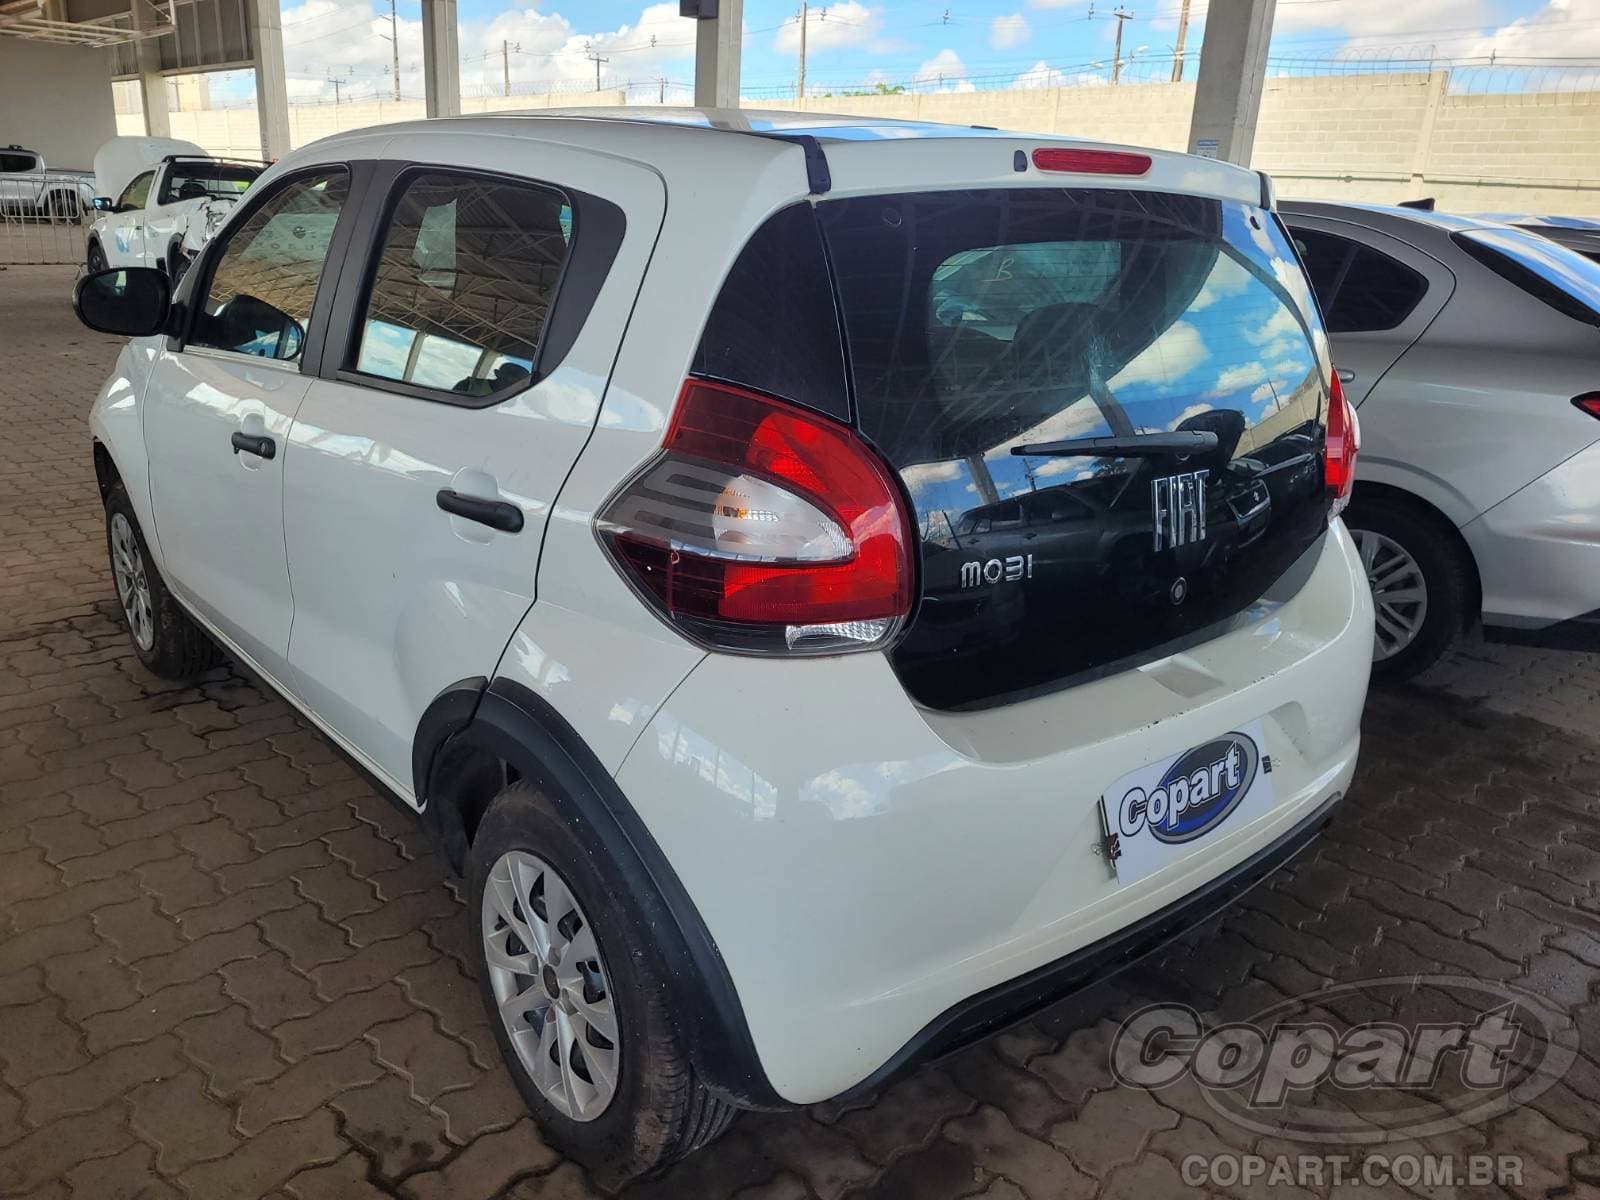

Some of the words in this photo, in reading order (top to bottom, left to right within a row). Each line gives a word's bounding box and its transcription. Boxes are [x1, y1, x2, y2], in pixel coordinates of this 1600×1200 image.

[1151, 469, 1209, 551] FIAT
[961, 554, 1033, 588] MOBI
[1119, 740, 1241, 838] Copart
